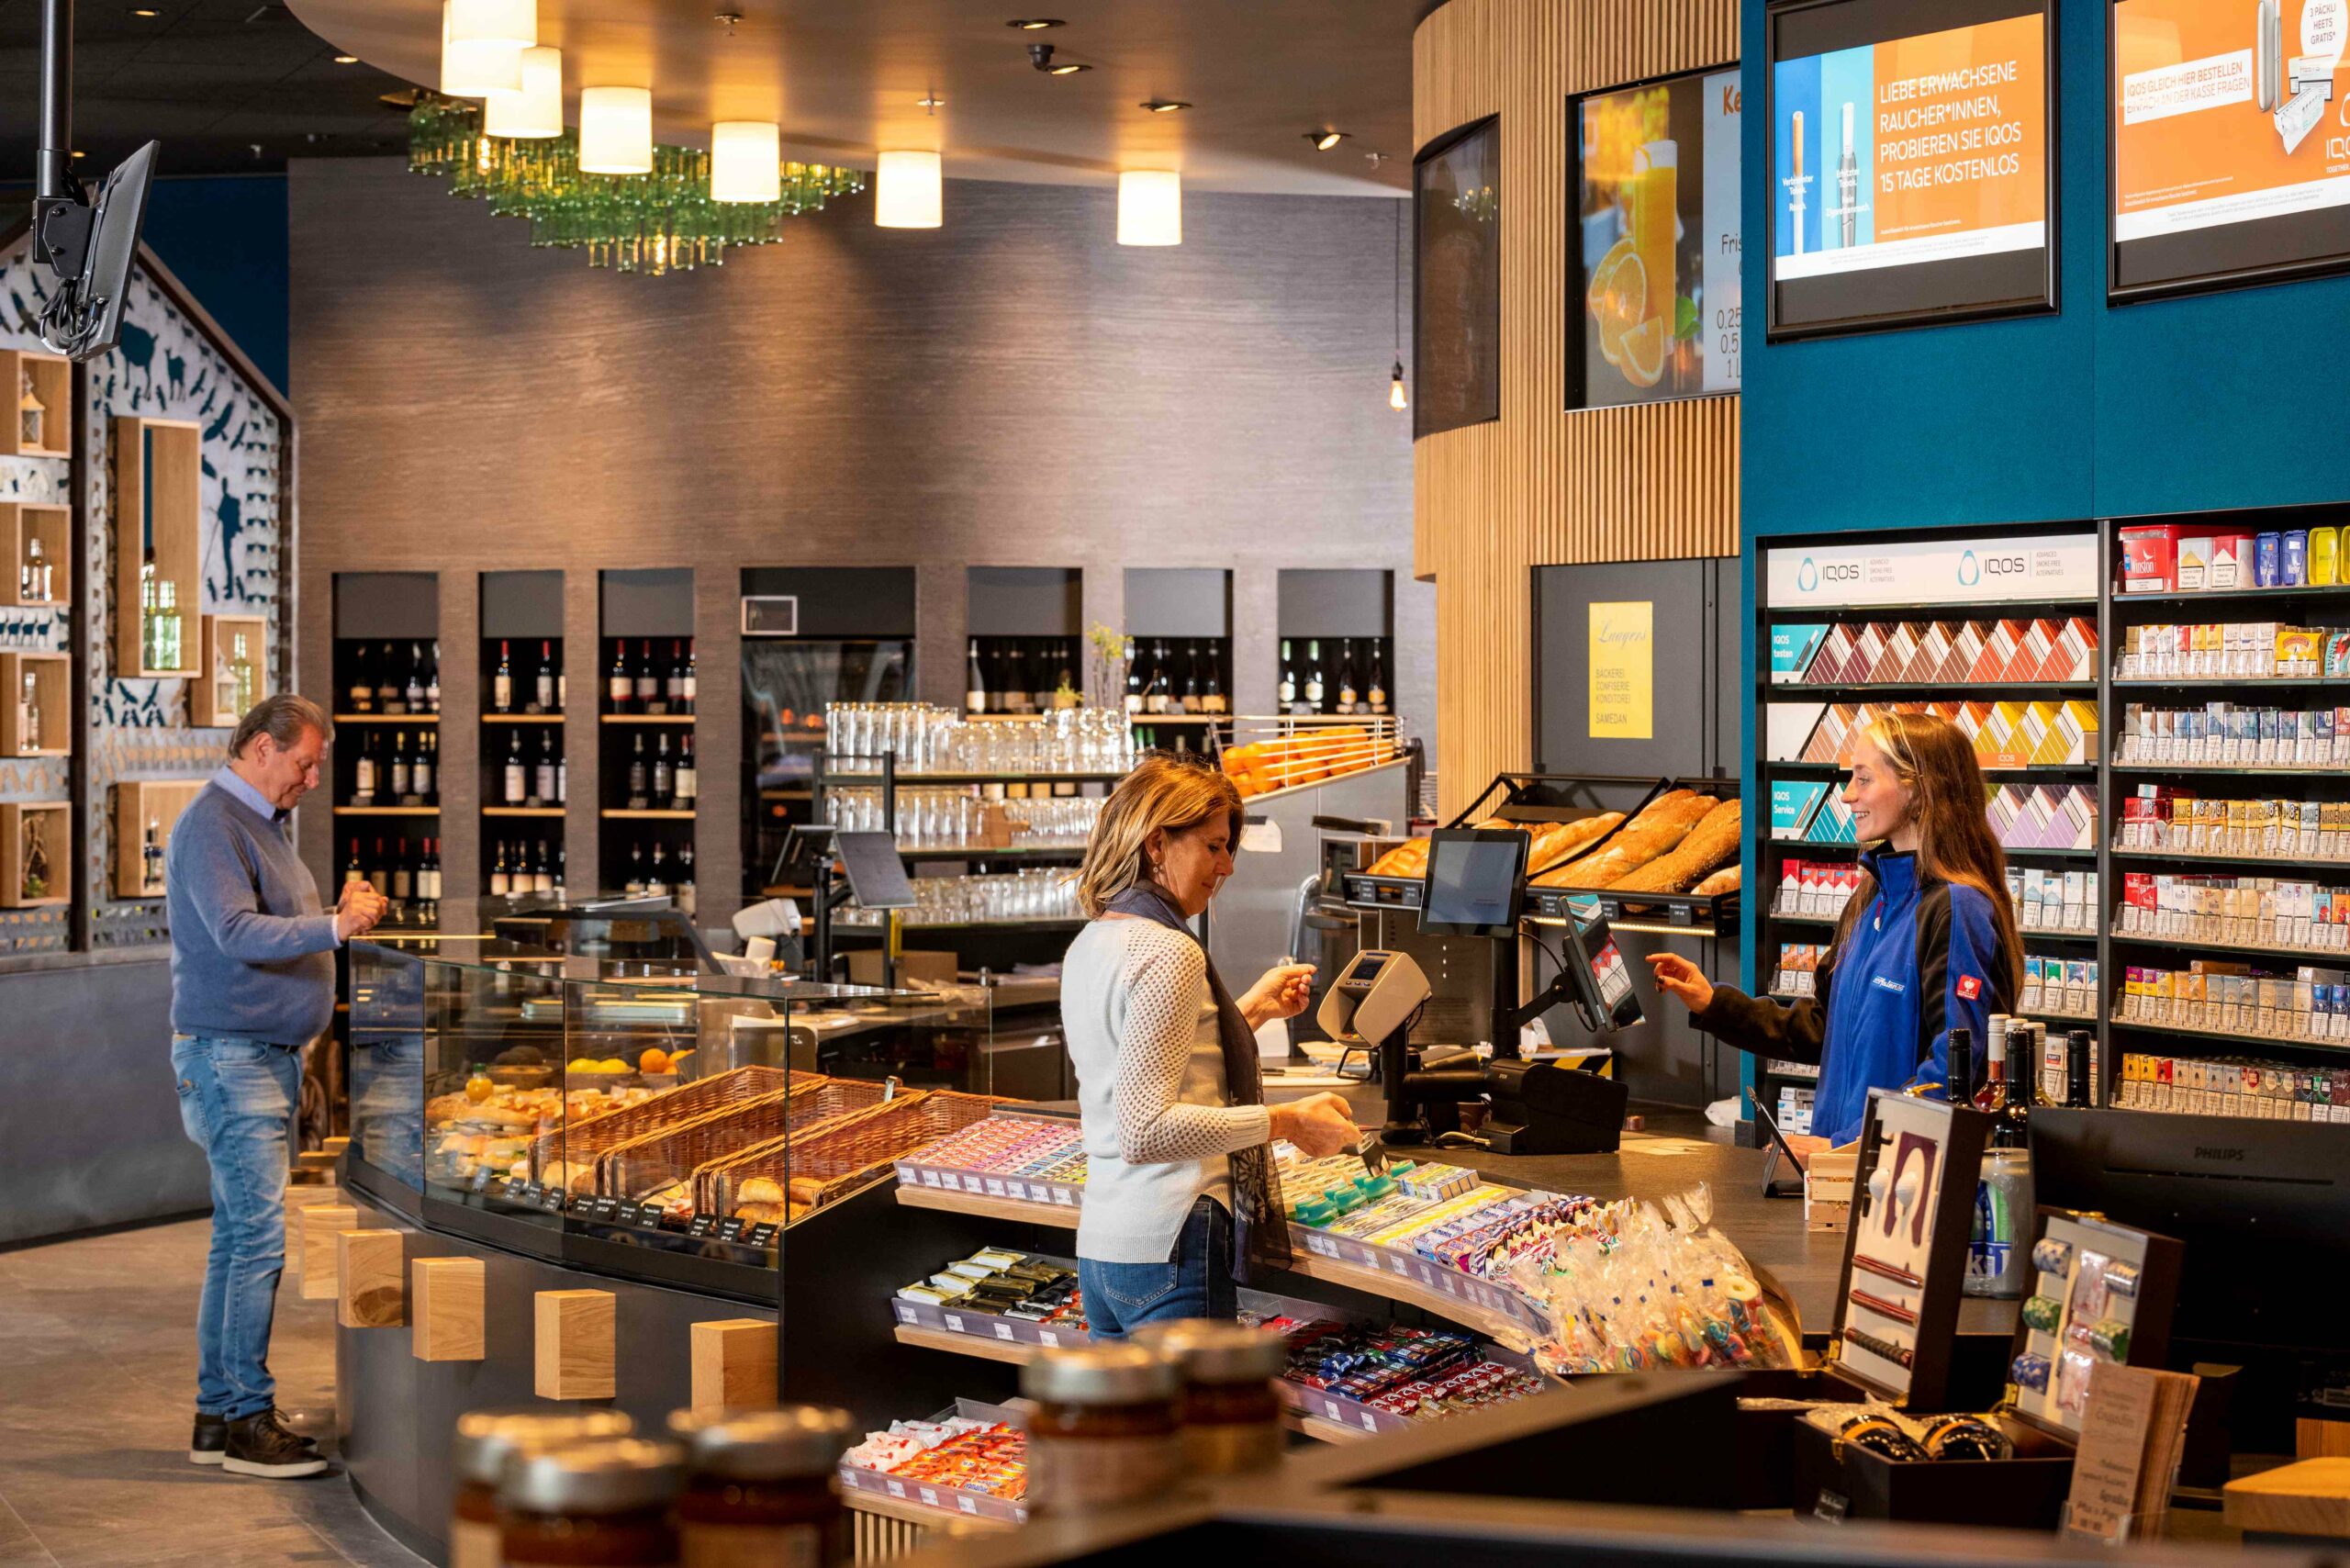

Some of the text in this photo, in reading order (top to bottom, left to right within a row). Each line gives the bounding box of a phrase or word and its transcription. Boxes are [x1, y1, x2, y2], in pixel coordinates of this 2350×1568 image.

[2313, 17, 2333, 30] HEETS
[1880, 60, 2018, 104] LIEBE ERWACHSENE
[2127, 61, 2243, 97] IQOS GLEICH HIER BESTELLEN
[2174, 89, 2189, 104] DER
[2190, 83, 2217, 100] KASSE
[2217, 76, 2251, 96] FRAGEN
[1880, 121, 2022, 163] PROBIEREN SIE IQOS
[1880, 152, 2020, 193] 15 TAGE KOSTENLOS
[1822, 565, 1860, 582] IQOS
[1985, 557, 2025, 577] IQOS
[2131, 557, 2154, 574] Winston
[1595, 712, 1628, 724] SAMEDAN
[2195, 1147, 2244, 1161] PHILIPS
